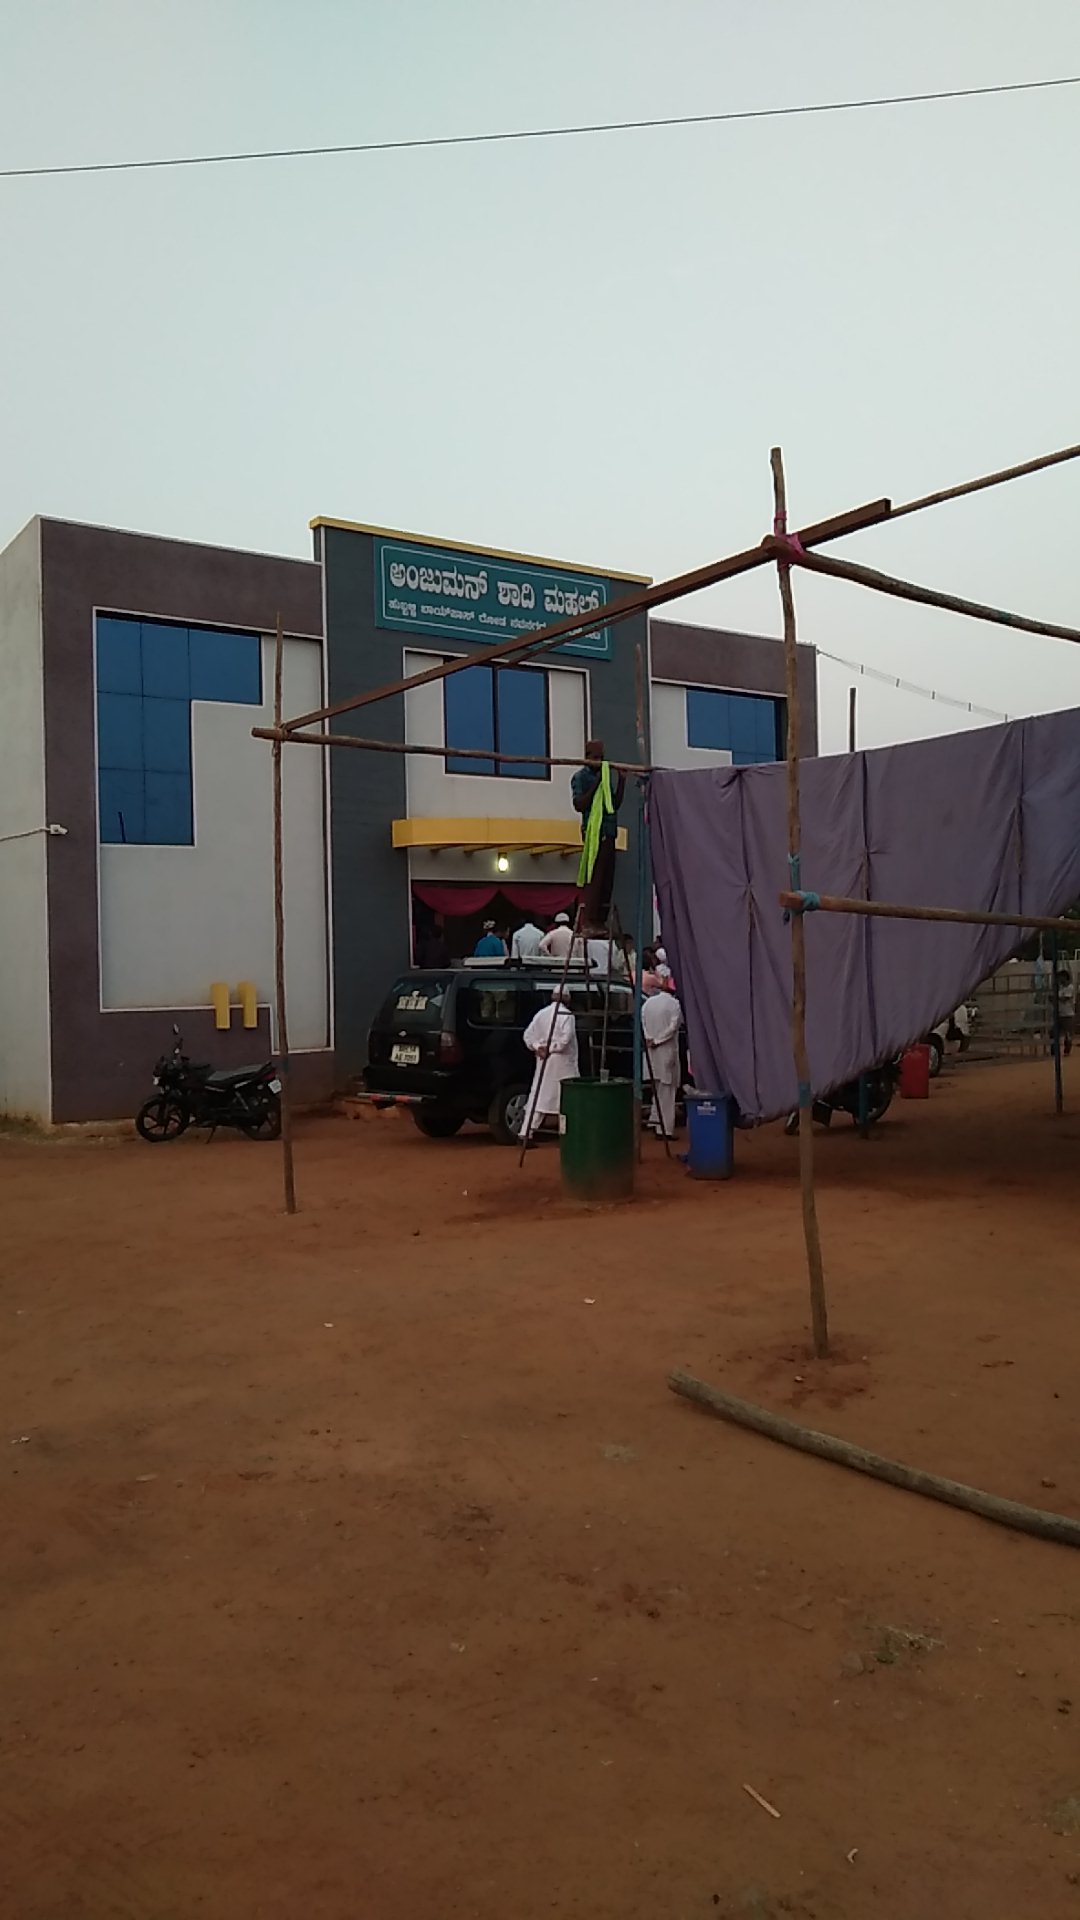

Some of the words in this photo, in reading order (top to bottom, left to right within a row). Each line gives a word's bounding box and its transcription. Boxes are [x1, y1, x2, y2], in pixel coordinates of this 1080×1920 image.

[389, 562, 488, 600] ಅಂಜುಮನ್
[496, 581, 535, 609] ಶಾದಿ
[543, 584, 600, 616] ಮಹಲ್
